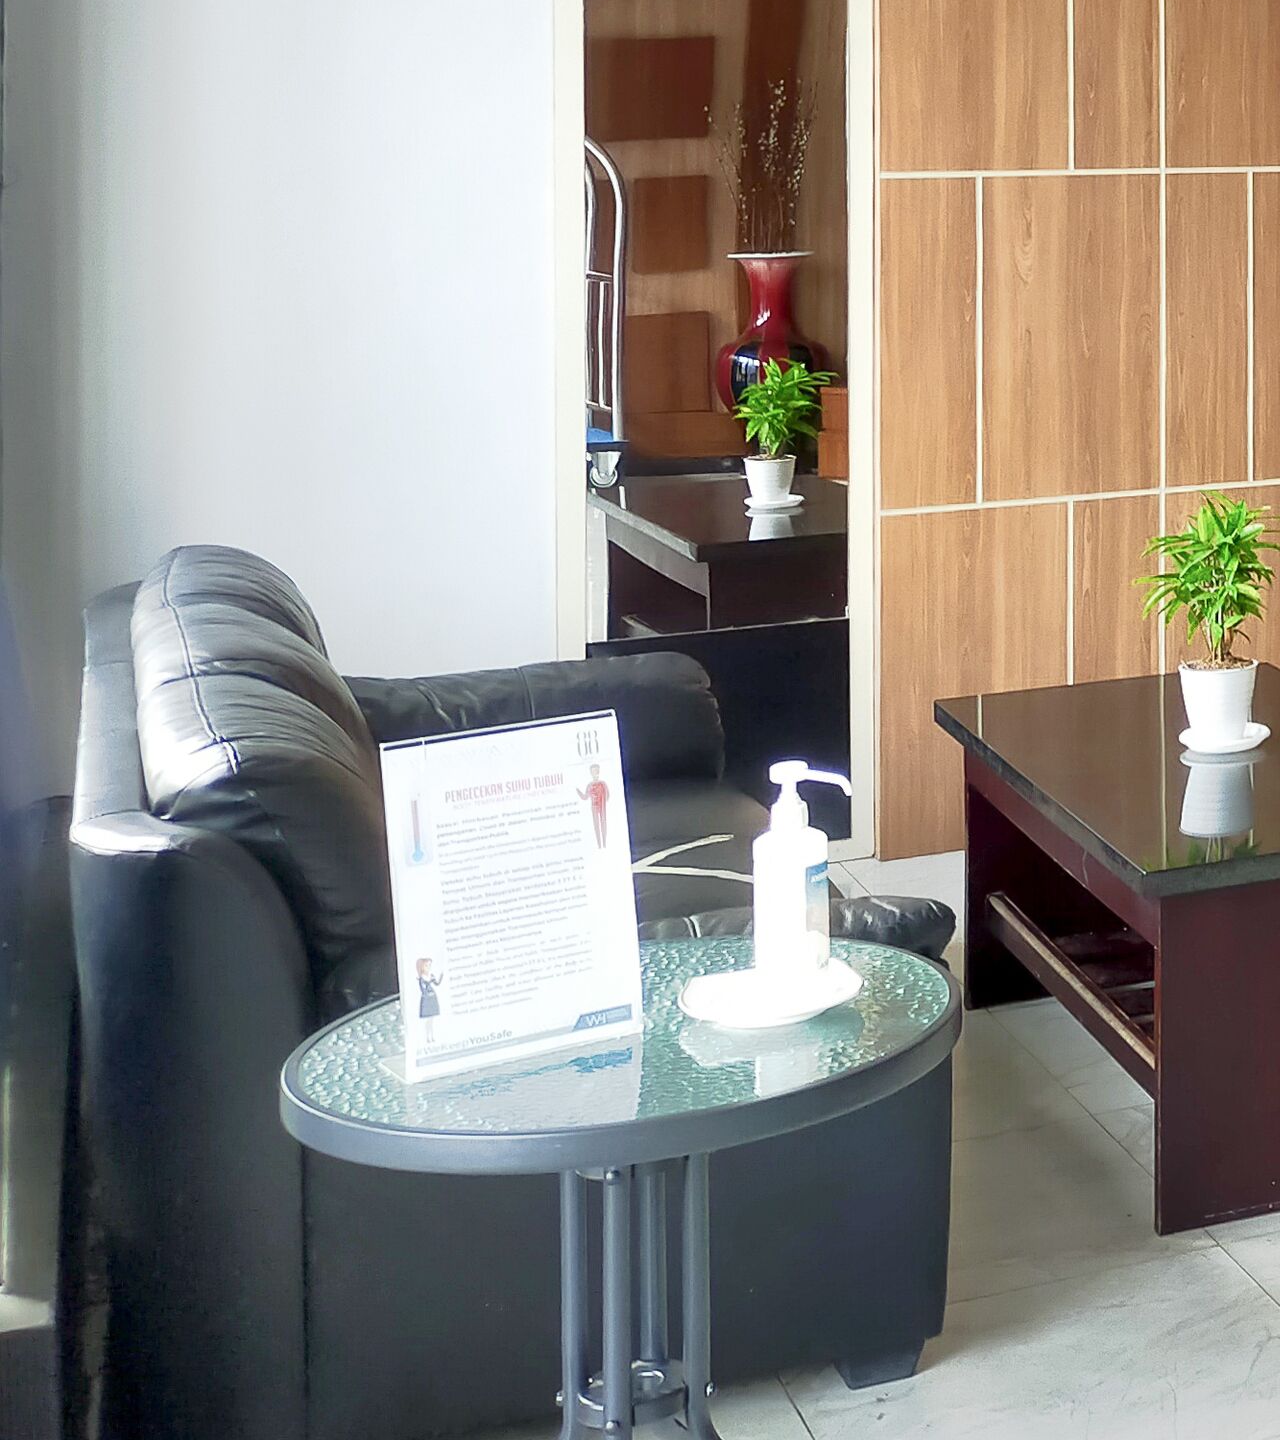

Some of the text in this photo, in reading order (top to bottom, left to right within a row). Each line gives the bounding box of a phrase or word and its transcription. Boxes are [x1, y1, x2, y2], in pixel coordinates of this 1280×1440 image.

[445, 772, 564, 803] PENGECEKAN SUHU TUBUH
